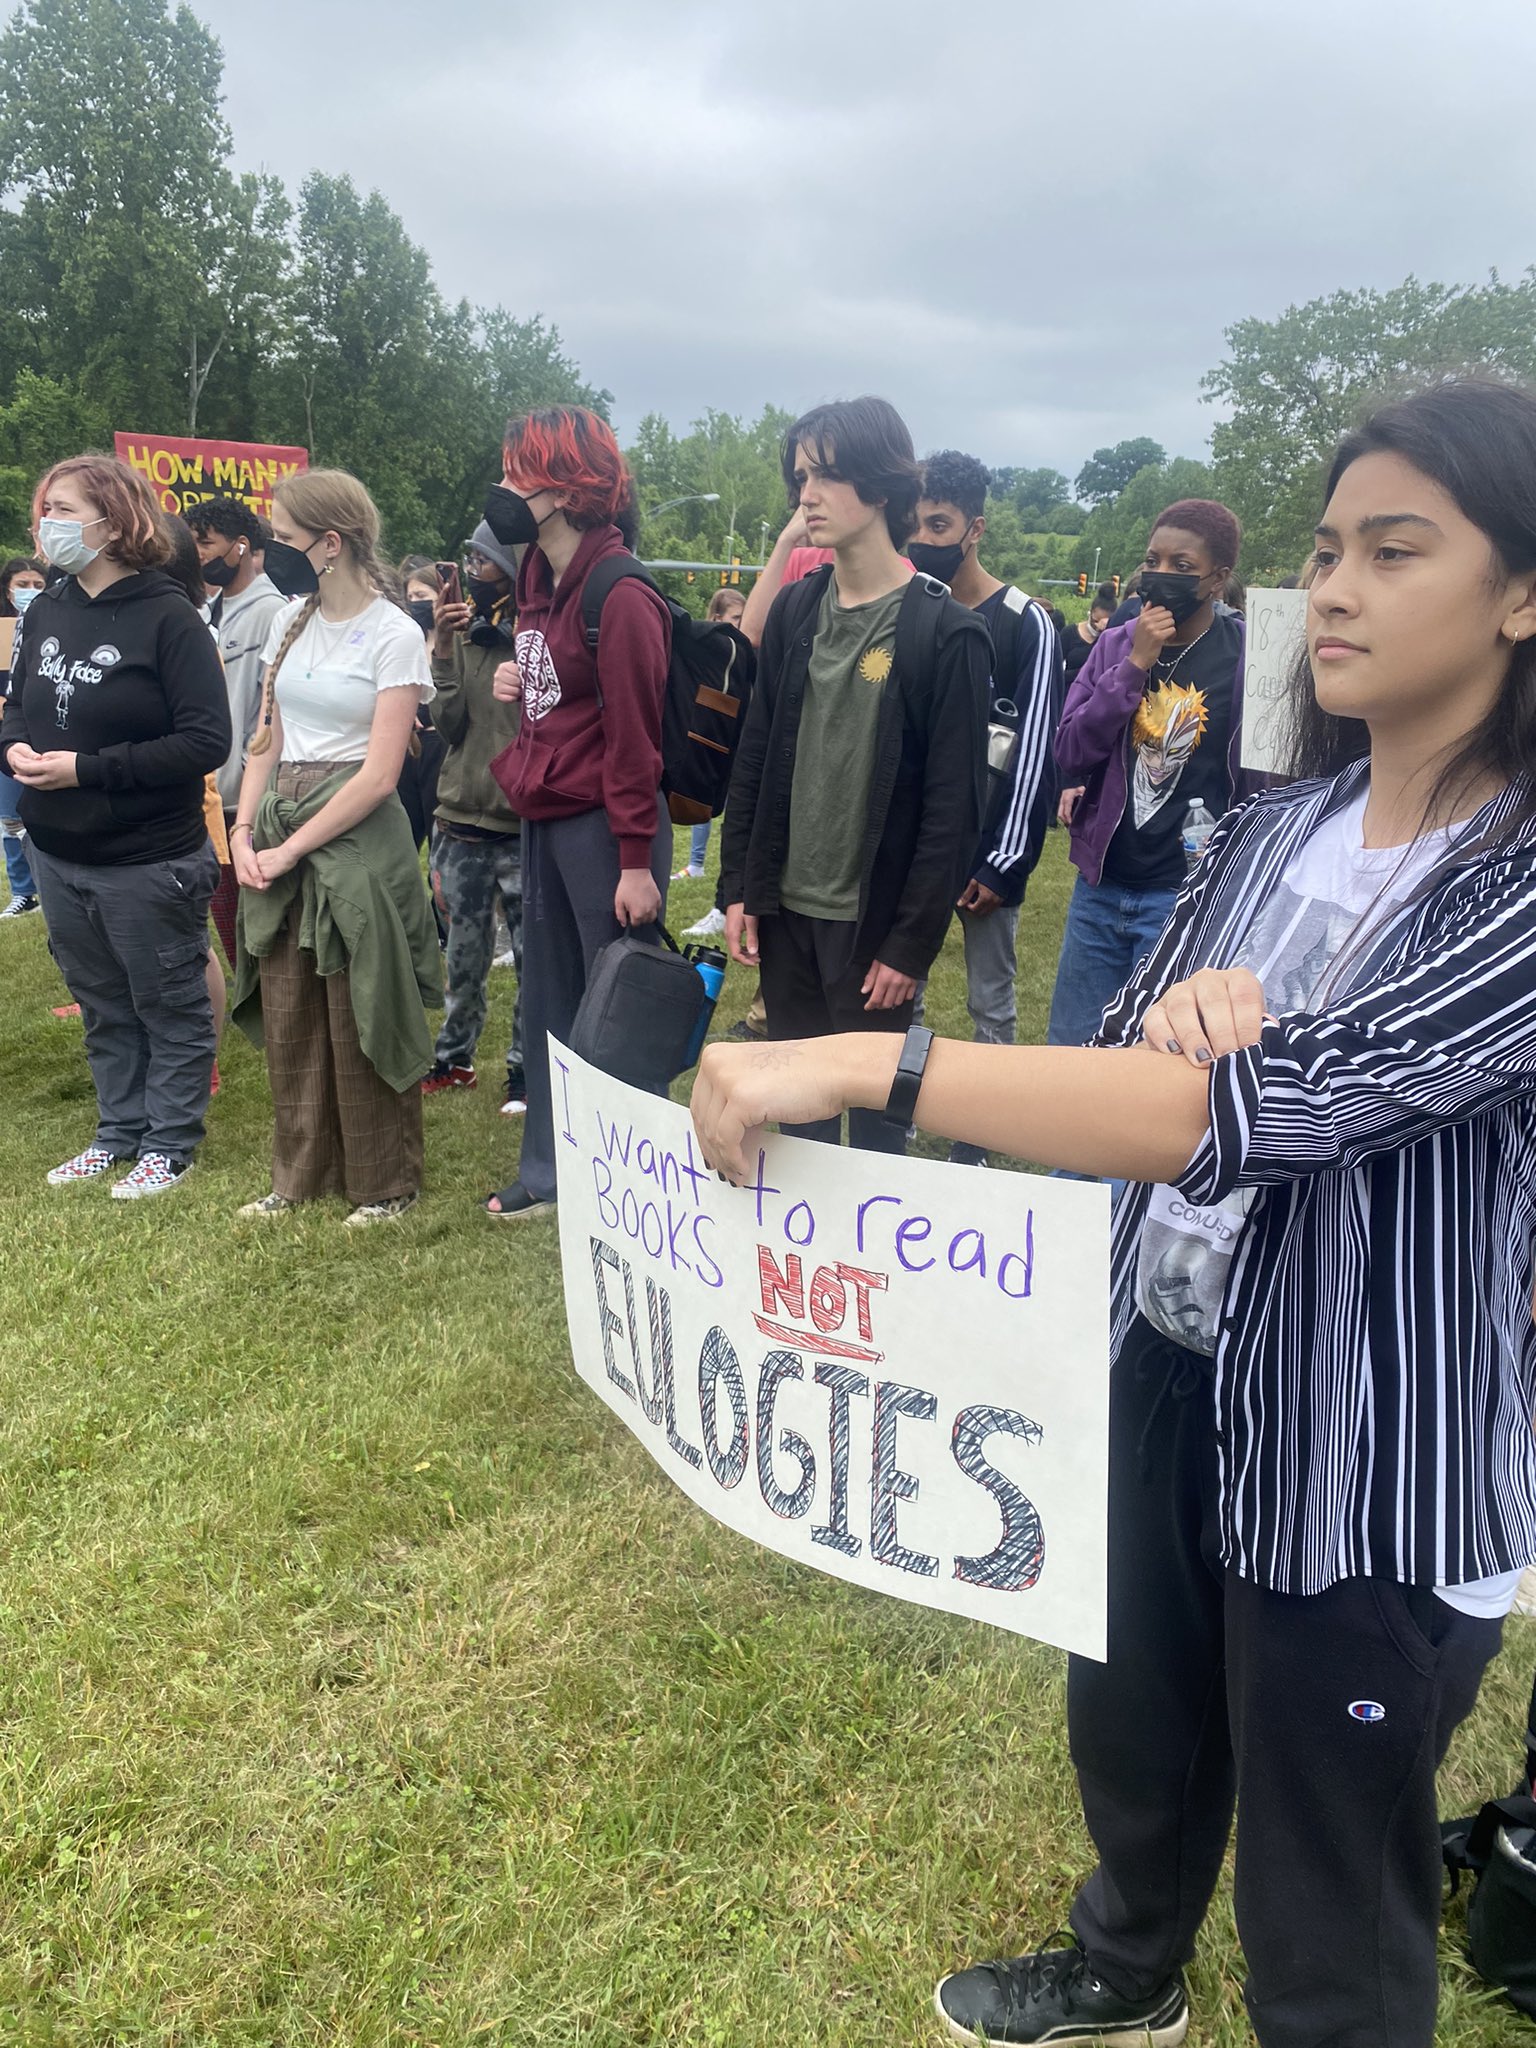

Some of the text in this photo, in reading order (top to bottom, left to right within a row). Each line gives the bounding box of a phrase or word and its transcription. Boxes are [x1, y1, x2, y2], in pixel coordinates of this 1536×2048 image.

[128, 446, 298, 492] HOW MANY
[38, 653, 103, 684] Sally Face
[554, 1056, 1035, 1299] I want to read
[592, 1156, 889, 1343] BOOKS NOT
[589, 1235, 1046, 1592] EULOGIES
